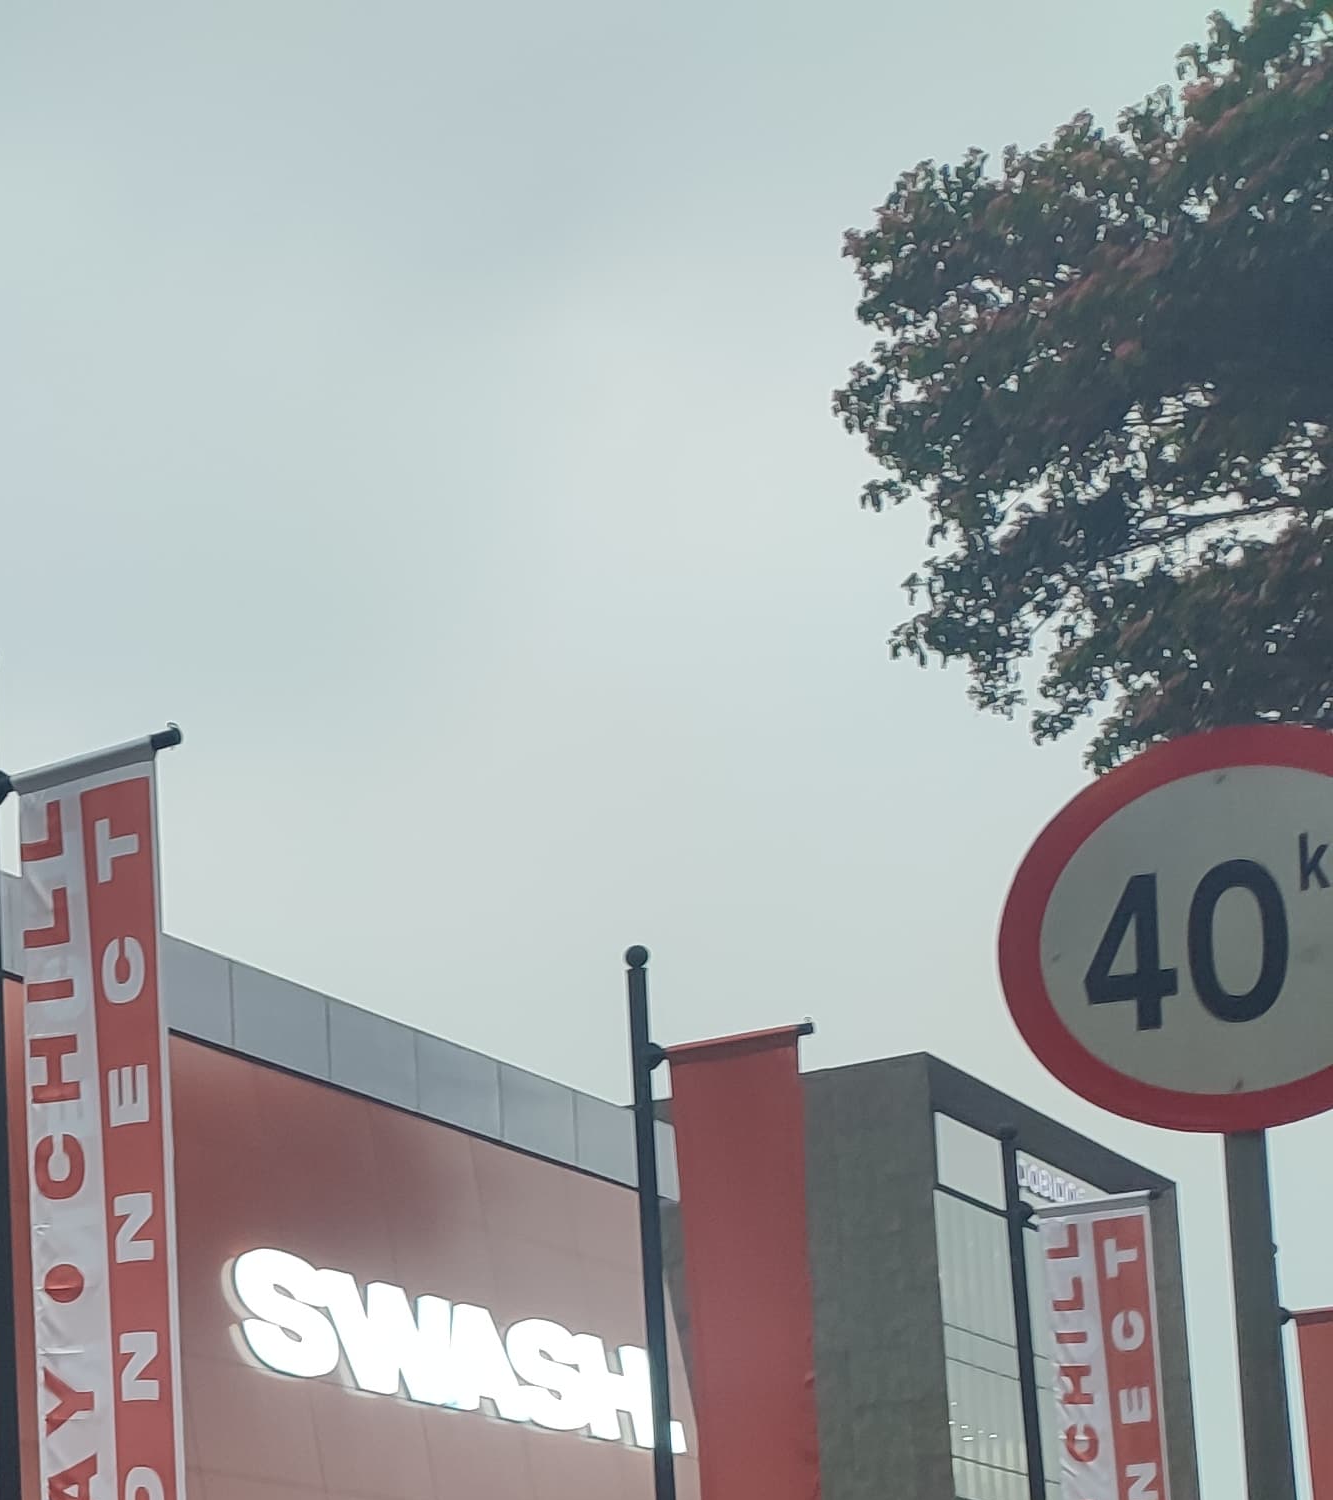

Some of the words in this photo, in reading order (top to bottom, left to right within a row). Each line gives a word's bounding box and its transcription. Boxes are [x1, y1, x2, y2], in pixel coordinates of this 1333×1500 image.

[20, 800, 86, 1201] CHILL
[1083, 858, 1289, 1032] 40
[1046, 1223, 1100, 1463] CHILL
